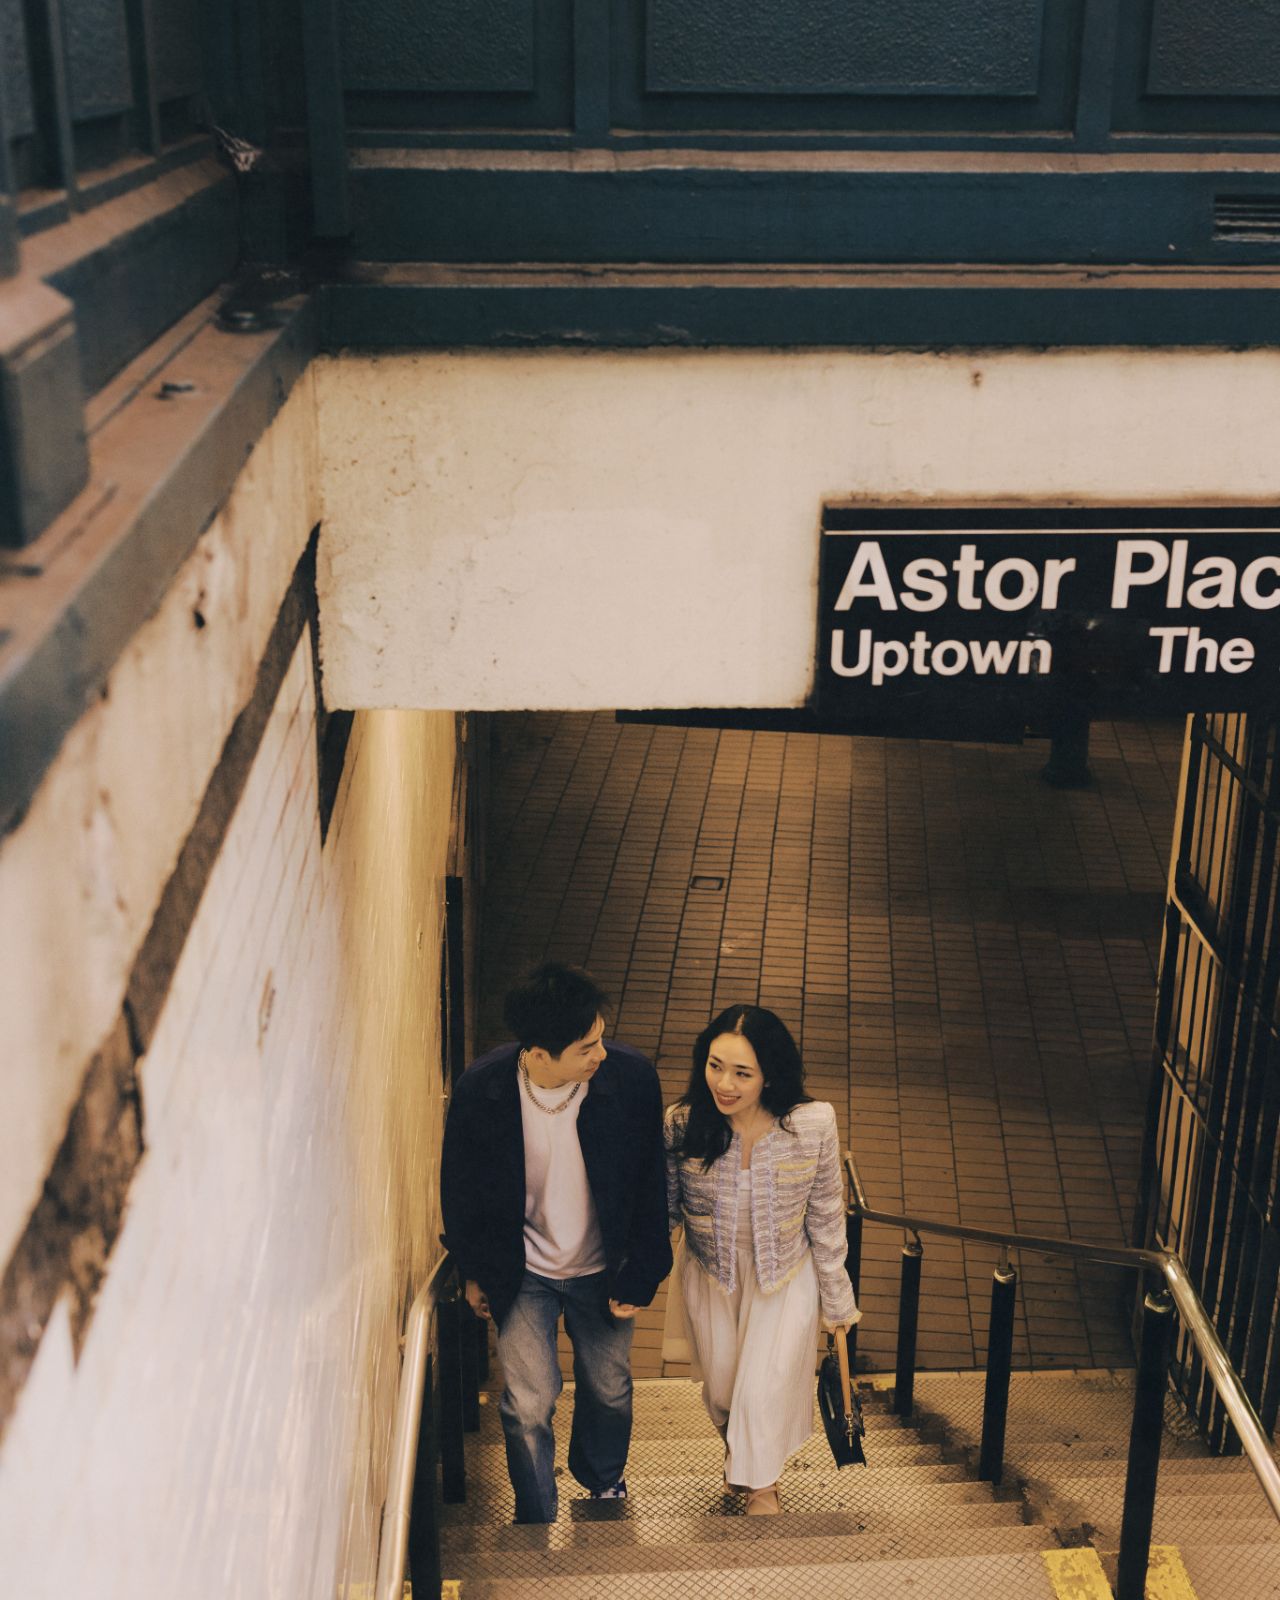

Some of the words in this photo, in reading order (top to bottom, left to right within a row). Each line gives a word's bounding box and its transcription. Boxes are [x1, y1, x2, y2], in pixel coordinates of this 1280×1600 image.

[833, 541, 1077, 613] Astor
[1110, 539, 1280, 611] Plac
[830, 628, 1052, 687] Uptown
[1148, 626, 1255, 675] The
